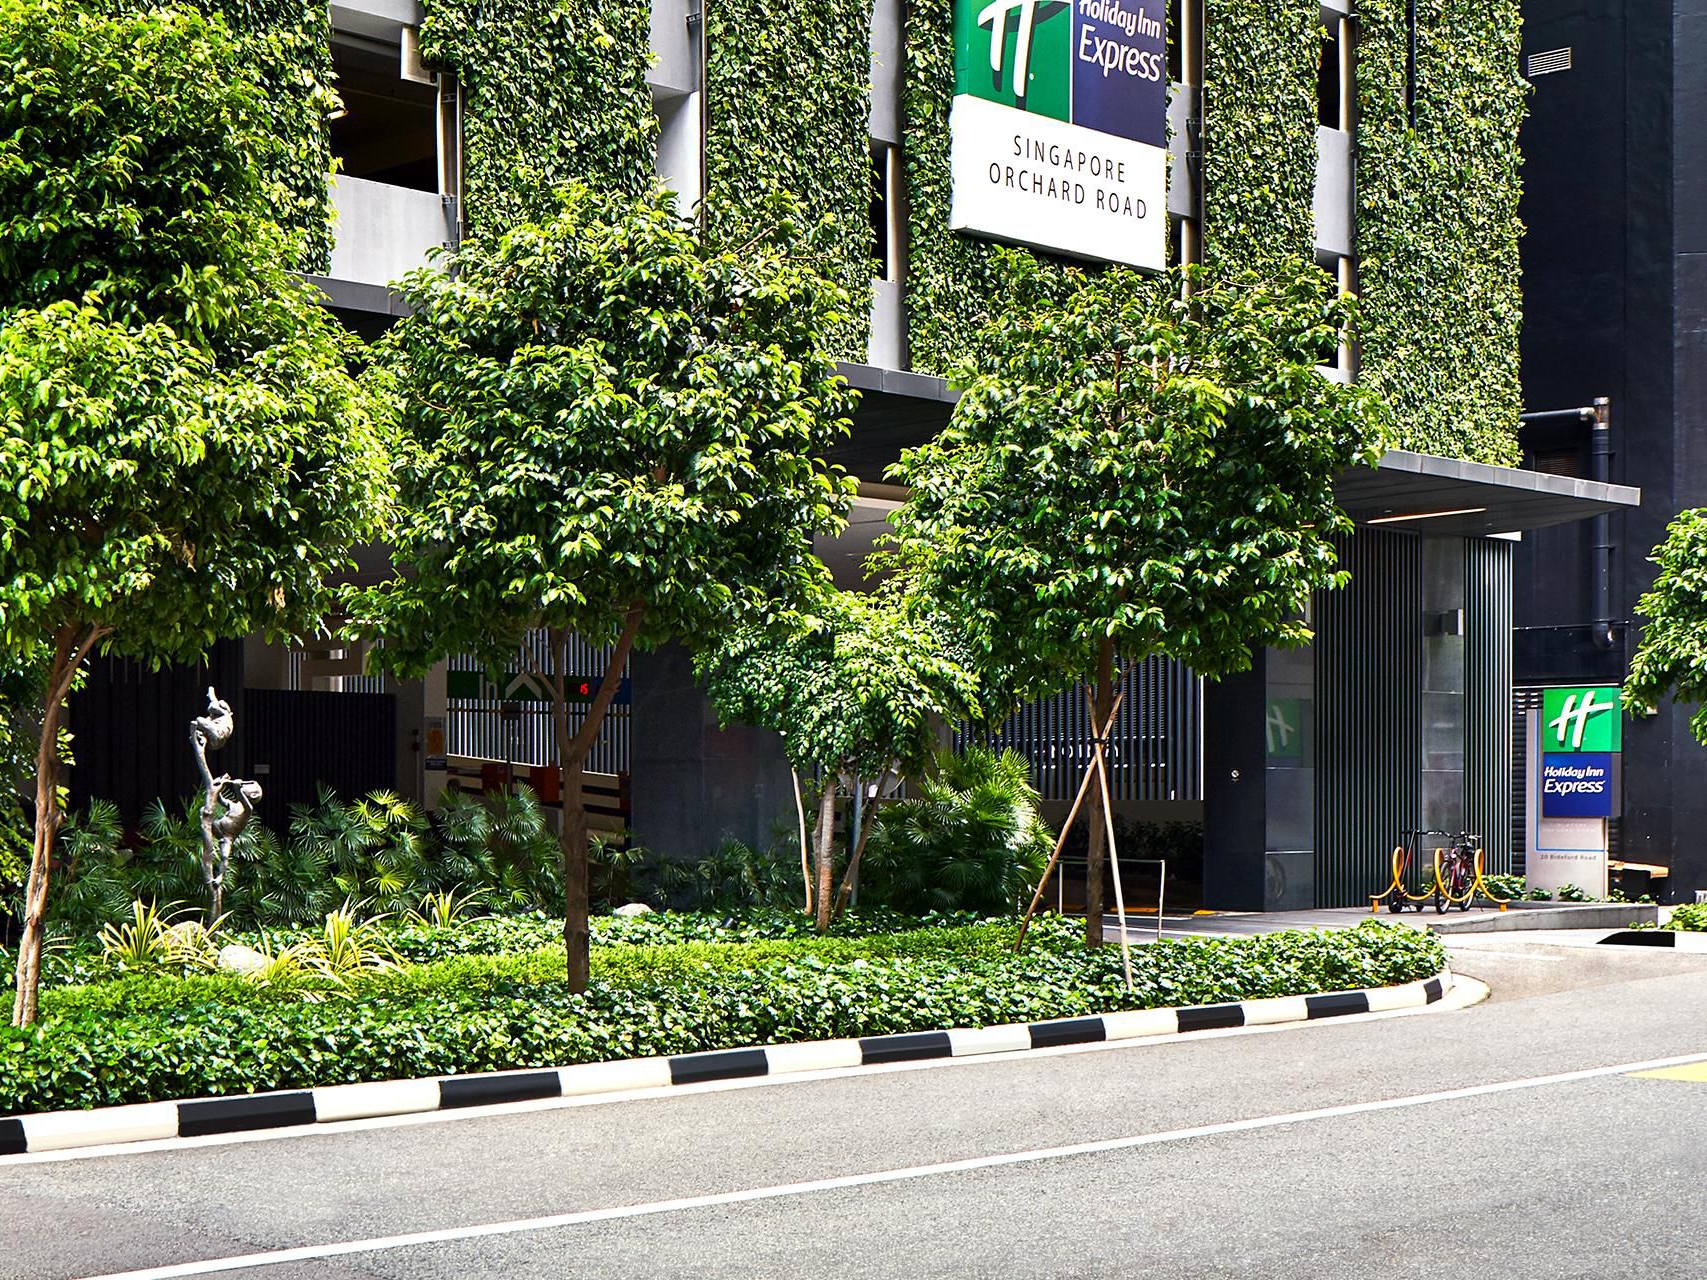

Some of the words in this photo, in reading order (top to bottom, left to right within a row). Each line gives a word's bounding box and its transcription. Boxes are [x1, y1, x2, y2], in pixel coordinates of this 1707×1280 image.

[1138, 7, 1161, 39] Inn
[1078, 26, 1161, 83] Express
[1013, 135, 1126, 183] SINGAPORE
[989, 163, 1086, 205] ORCHARD
[1096, 191, 1148, 219] ROAD
[1544, 766, 1585, 779] Holiday
[1585, 767, 1604, 777] Inn
[1544, 778, 1604, 796] Express
